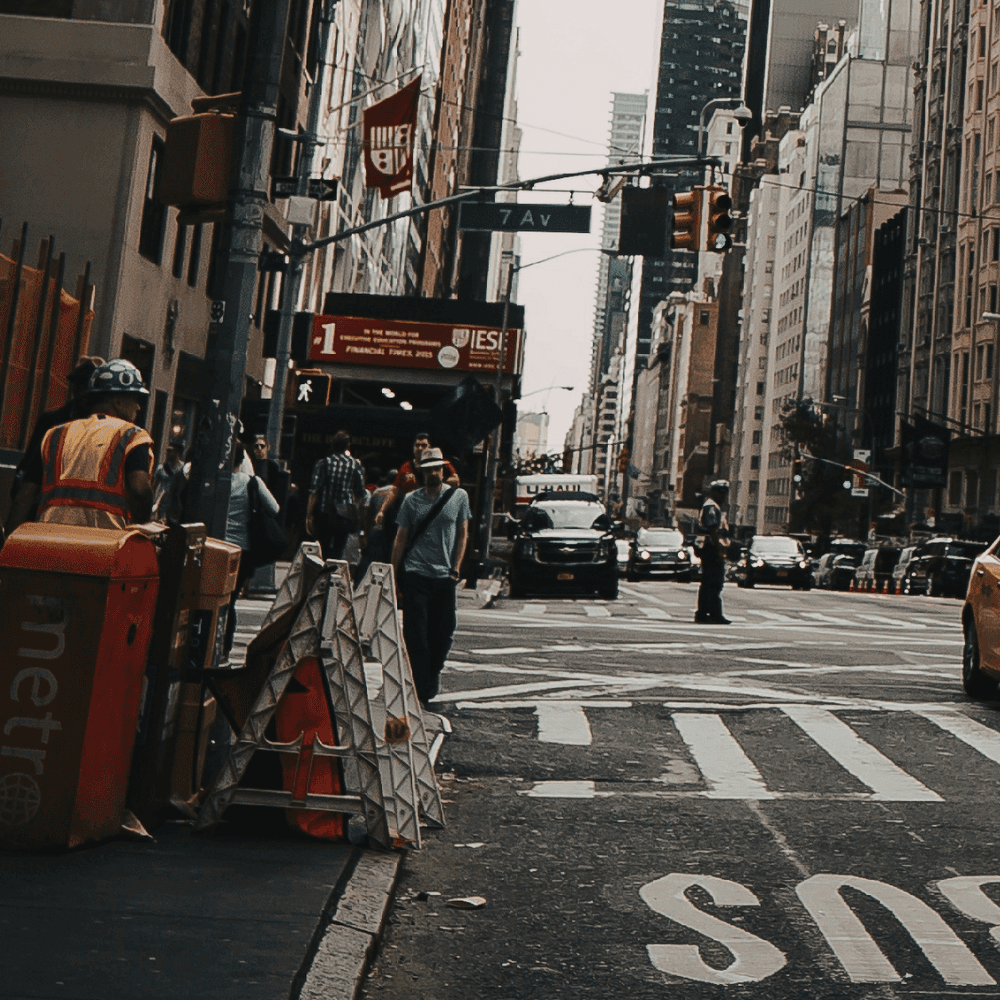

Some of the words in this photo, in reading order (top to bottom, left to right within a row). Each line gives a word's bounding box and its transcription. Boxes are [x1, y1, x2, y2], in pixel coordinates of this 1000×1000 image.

[499, 208, 512, 225] 7
[519, 209, 551, 227] Av
[313, 322, 336, 355] #1
